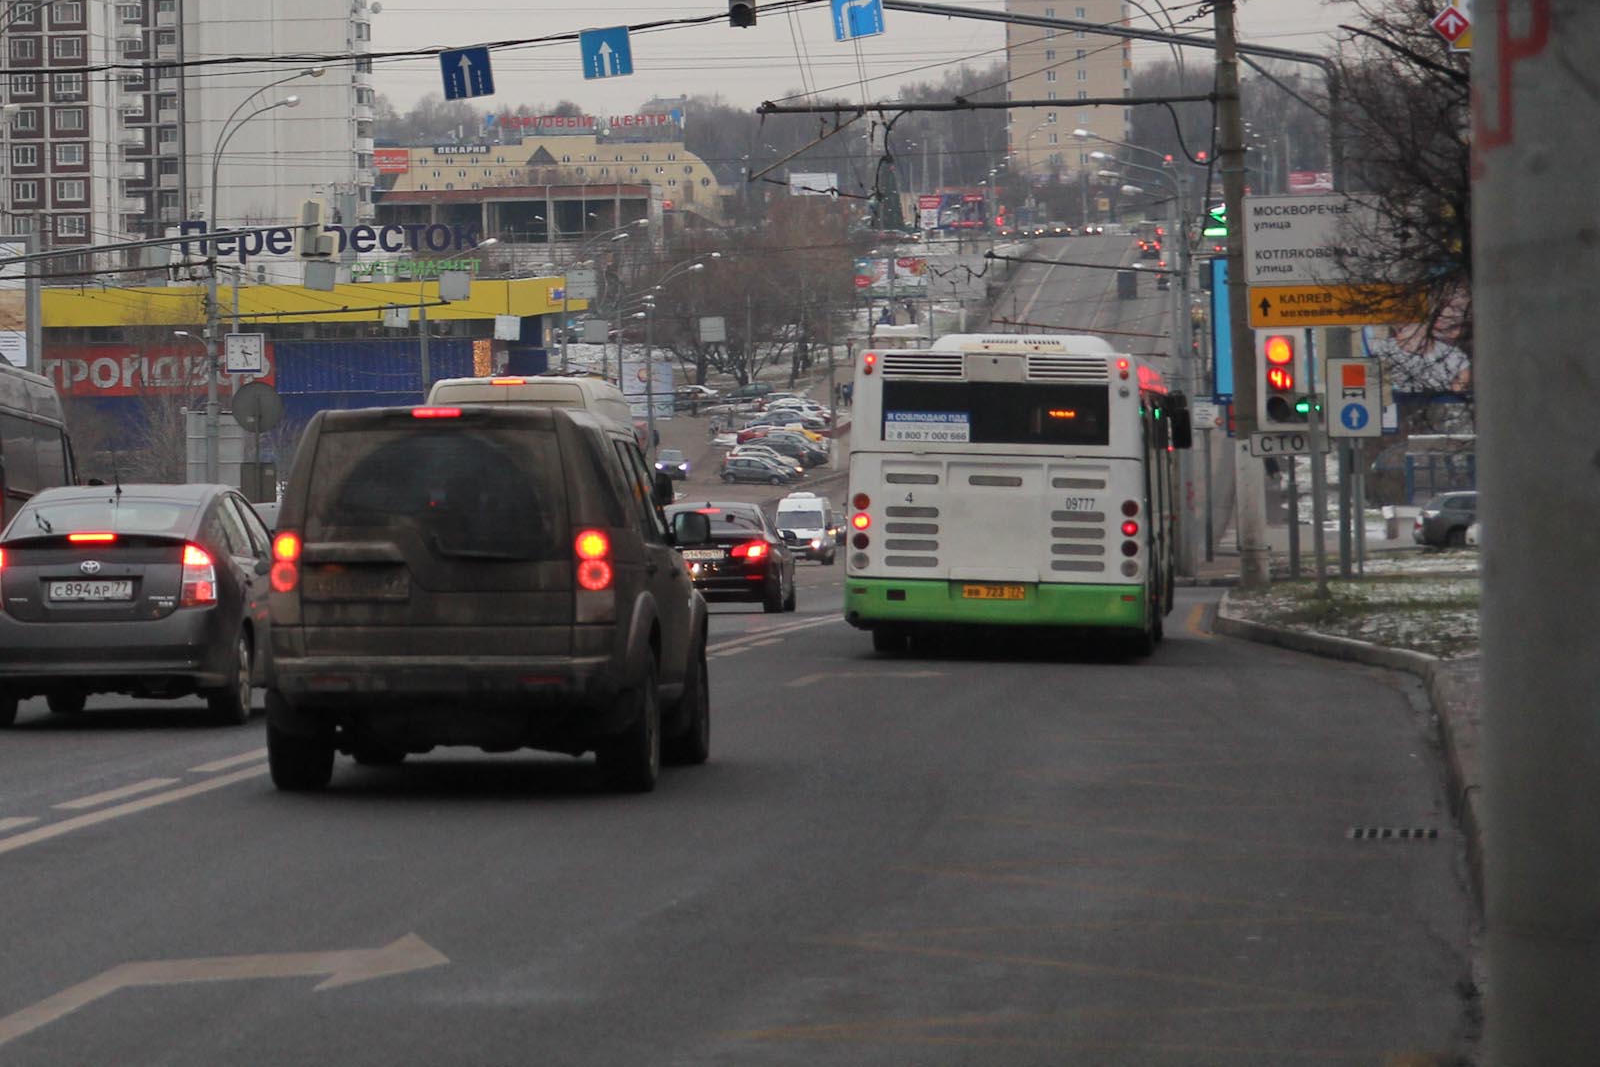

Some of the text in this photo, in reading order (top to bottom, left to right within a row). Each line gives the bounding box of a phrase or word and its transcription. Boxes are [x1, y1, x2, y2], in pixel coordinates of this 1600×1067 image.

[500, 113, 667, 129] ТОРГОВЫЙ ЦЕНТР
[437, 145, 487, 155] ПЕКАРНЯ
[1253, 204, 1353, 216] МОСКВОРЕЧЬЕ
[1253, 220, 1292, 232] улица
[1255, 264, 1294, 276] улица
[1279, 293, 1332, 304] КАЛЯЕВ
[895, 413, 947, 421] СОБЛЮДАЮ
[905, 492, 913, 503] 4
[1065, 497, 1096, 511] 09777
